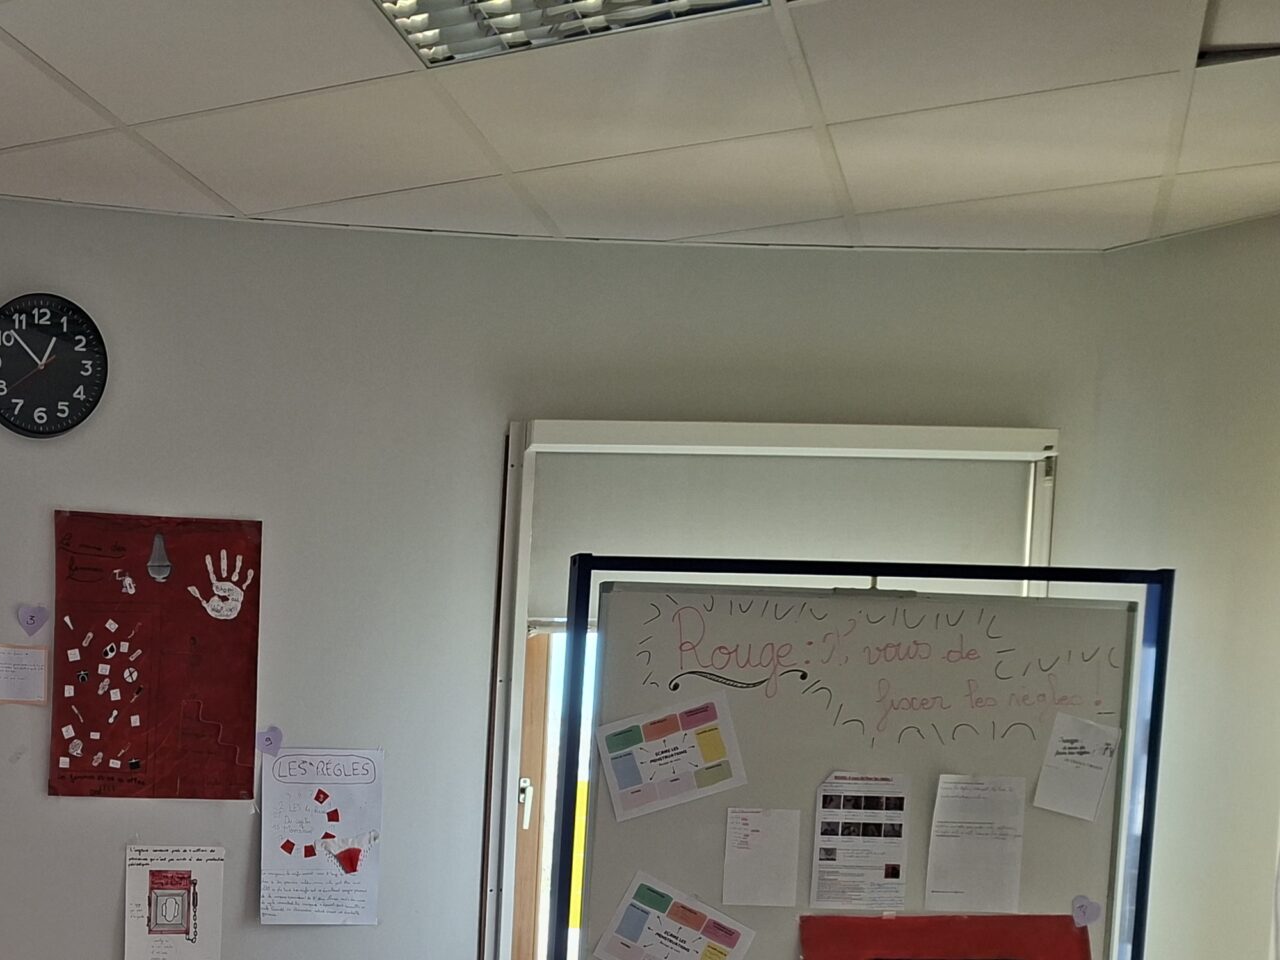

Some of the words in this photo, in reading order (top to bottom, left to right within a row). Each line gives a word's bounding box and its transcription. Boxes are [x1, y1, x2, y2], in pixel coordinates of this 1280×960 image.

[12, 313, 26, 330] 11
[32, 308, 51, 325] 12
[60, 316, 68, 333] 1
[74, 335, 87, 351] 2
[80, 360, 93, 376] 3
[73, 385, 86, 400] 4
[11, 399, 24, 415] 7
[56, 402, 69, 418] 5
[33, 407, 47, 424] 6
[26, 615, 36, 625] 3
[863, 641, 932, 665] vous
[946, 633, 981, 663] de
[965, 679, 998, 709] les
[265, 736, 272, 746] 9
[277, 760, 308, 778] LES
